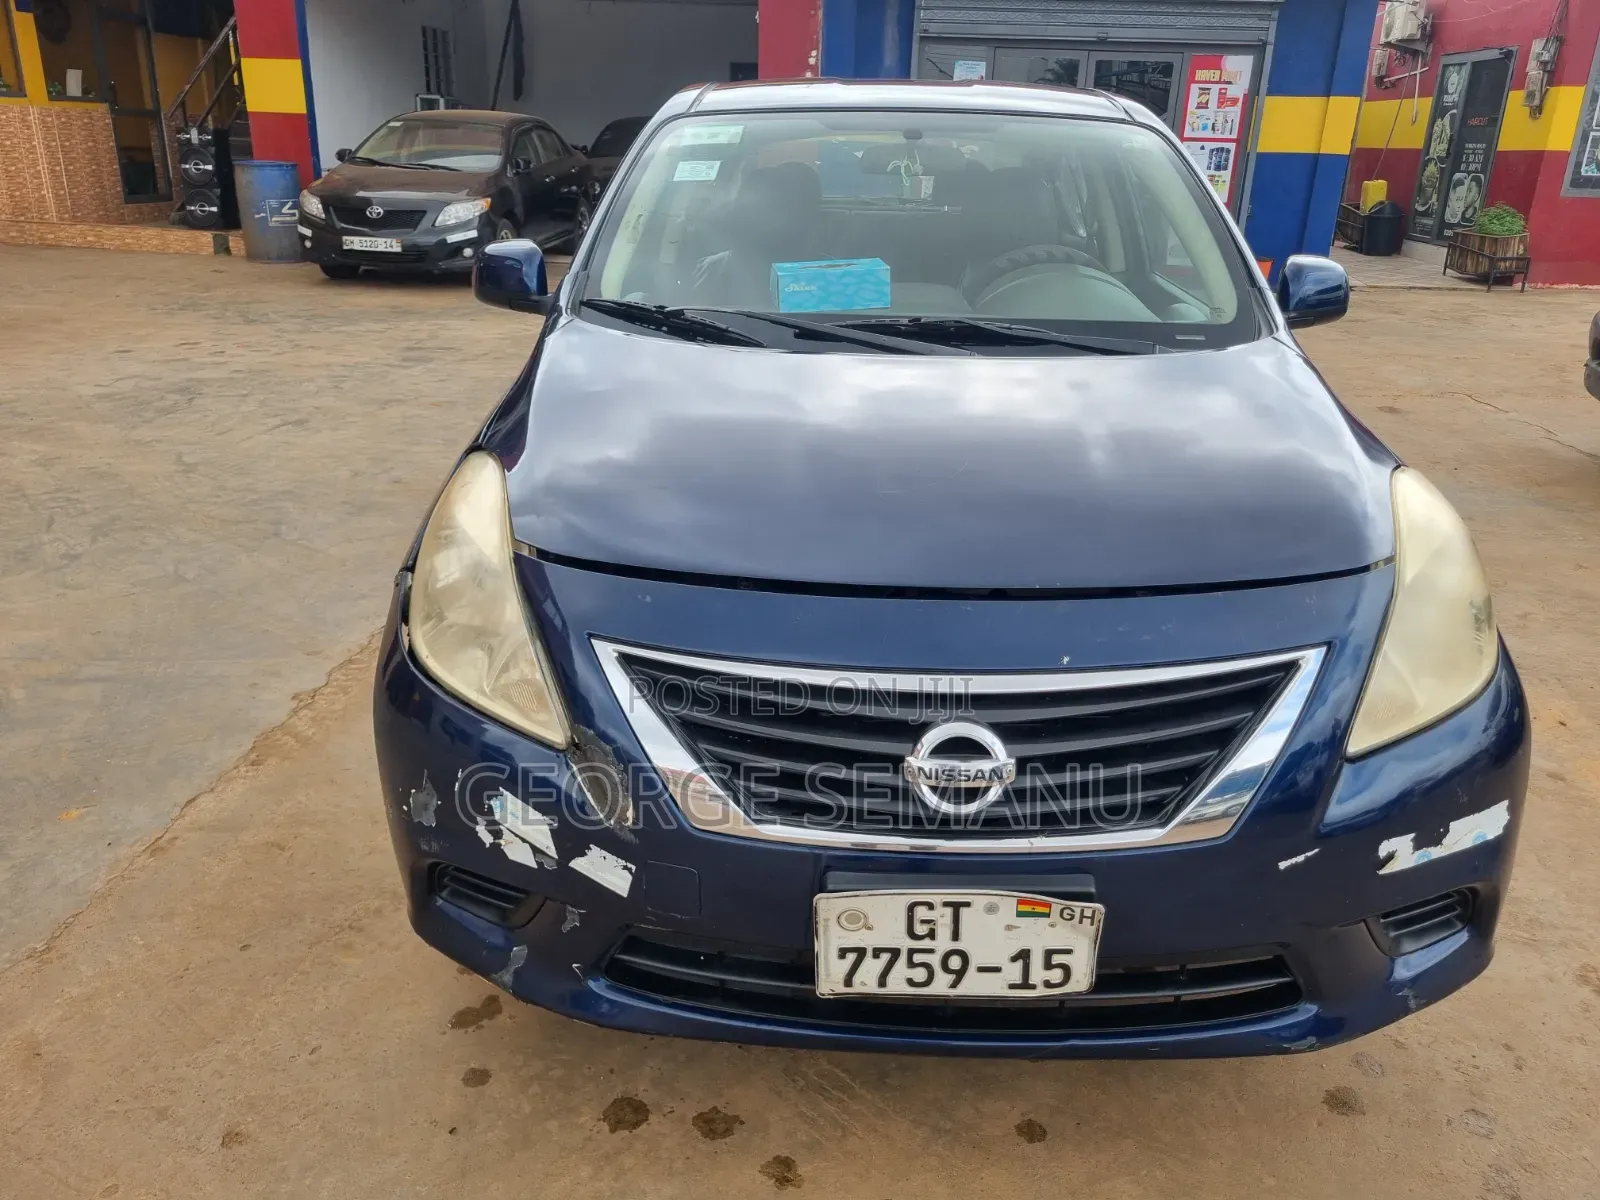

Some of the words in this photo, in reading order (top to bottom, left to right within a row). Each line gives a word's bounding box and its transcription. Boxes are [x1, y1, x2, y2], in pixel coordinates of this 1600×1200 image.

[917, 766, 1005, 783] NISSAN
[906, 900, 972, 942] GT
[1058, 905, 1097, 927] GH
[837, 946, 1074, 989] 7759-15
